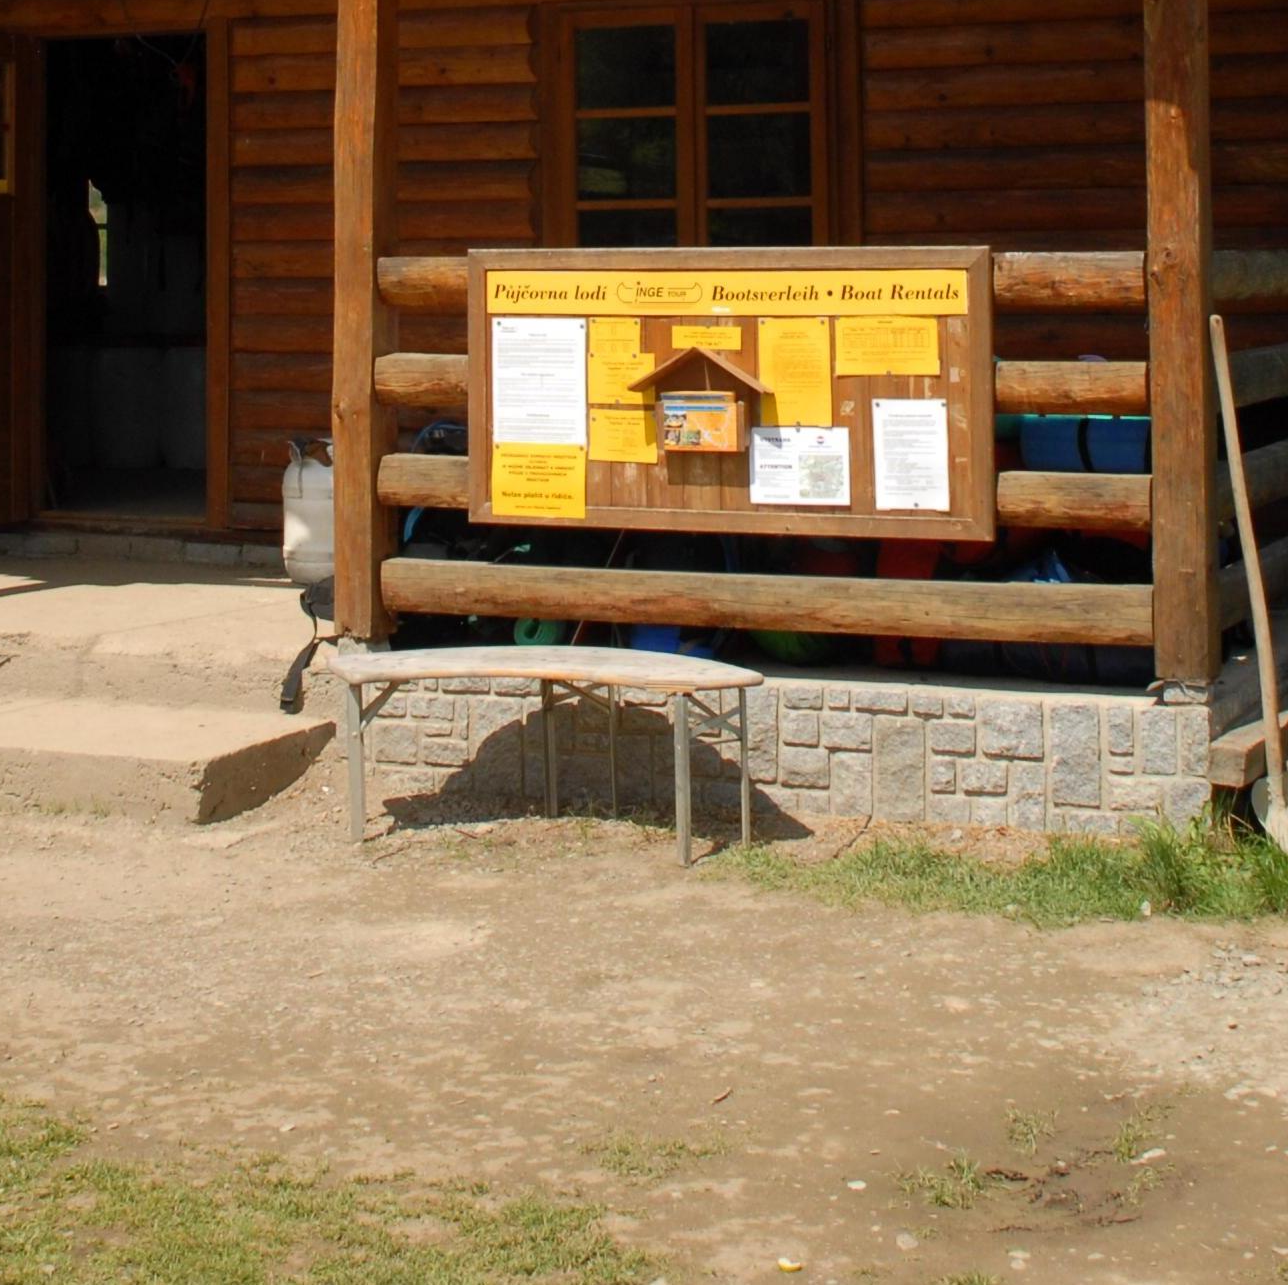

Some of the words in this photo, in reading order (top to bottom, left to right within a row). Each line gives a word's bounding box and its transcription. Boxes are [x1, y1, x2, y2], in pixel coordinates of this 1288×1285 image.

[494, 284, 569, 304] Půjčovna
[574, 284, 608, 301] lodí
[712, 284, 819, 301] Bootsverleih
[840, 284, 882, 300] Boat
[890, 283, 959, 300] Rentals
